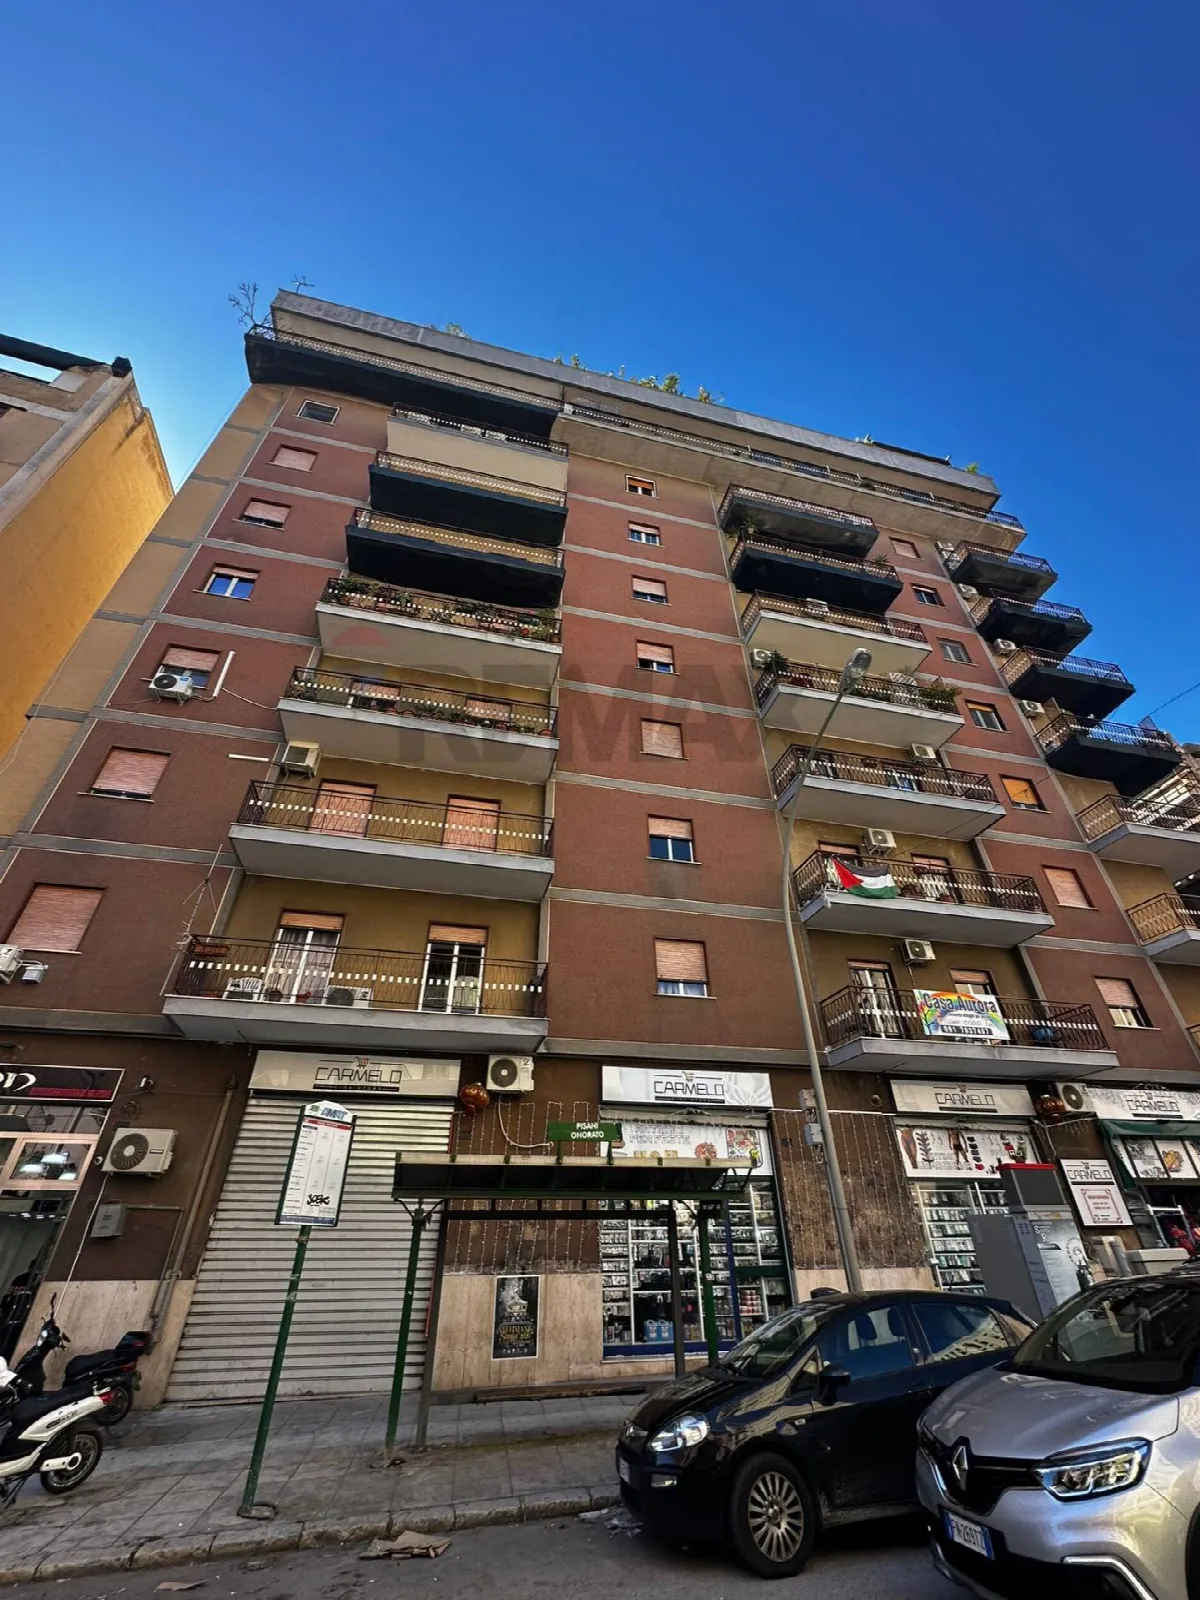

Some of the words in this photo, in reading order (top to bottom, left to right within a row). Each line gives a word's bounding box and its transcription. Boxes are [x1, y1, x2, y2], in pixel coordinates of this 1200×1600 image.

[923, 993, 954, 1009] Casa
[957, 996, 998, 1013] Aurora
[314, 1067, 403, 1084] CARMELO
[653, 1081, 725, 1096] CARMELO
[934, 1092, 996, 1106] CARMELO
[1125, 1100, 1181, 1112] CARMELO
[576, 1122, 599, 1130] PISANI
[571, 1130, 605, 1139] ONORATO
[1066, 1169, 1113, 1180] CARMELO
